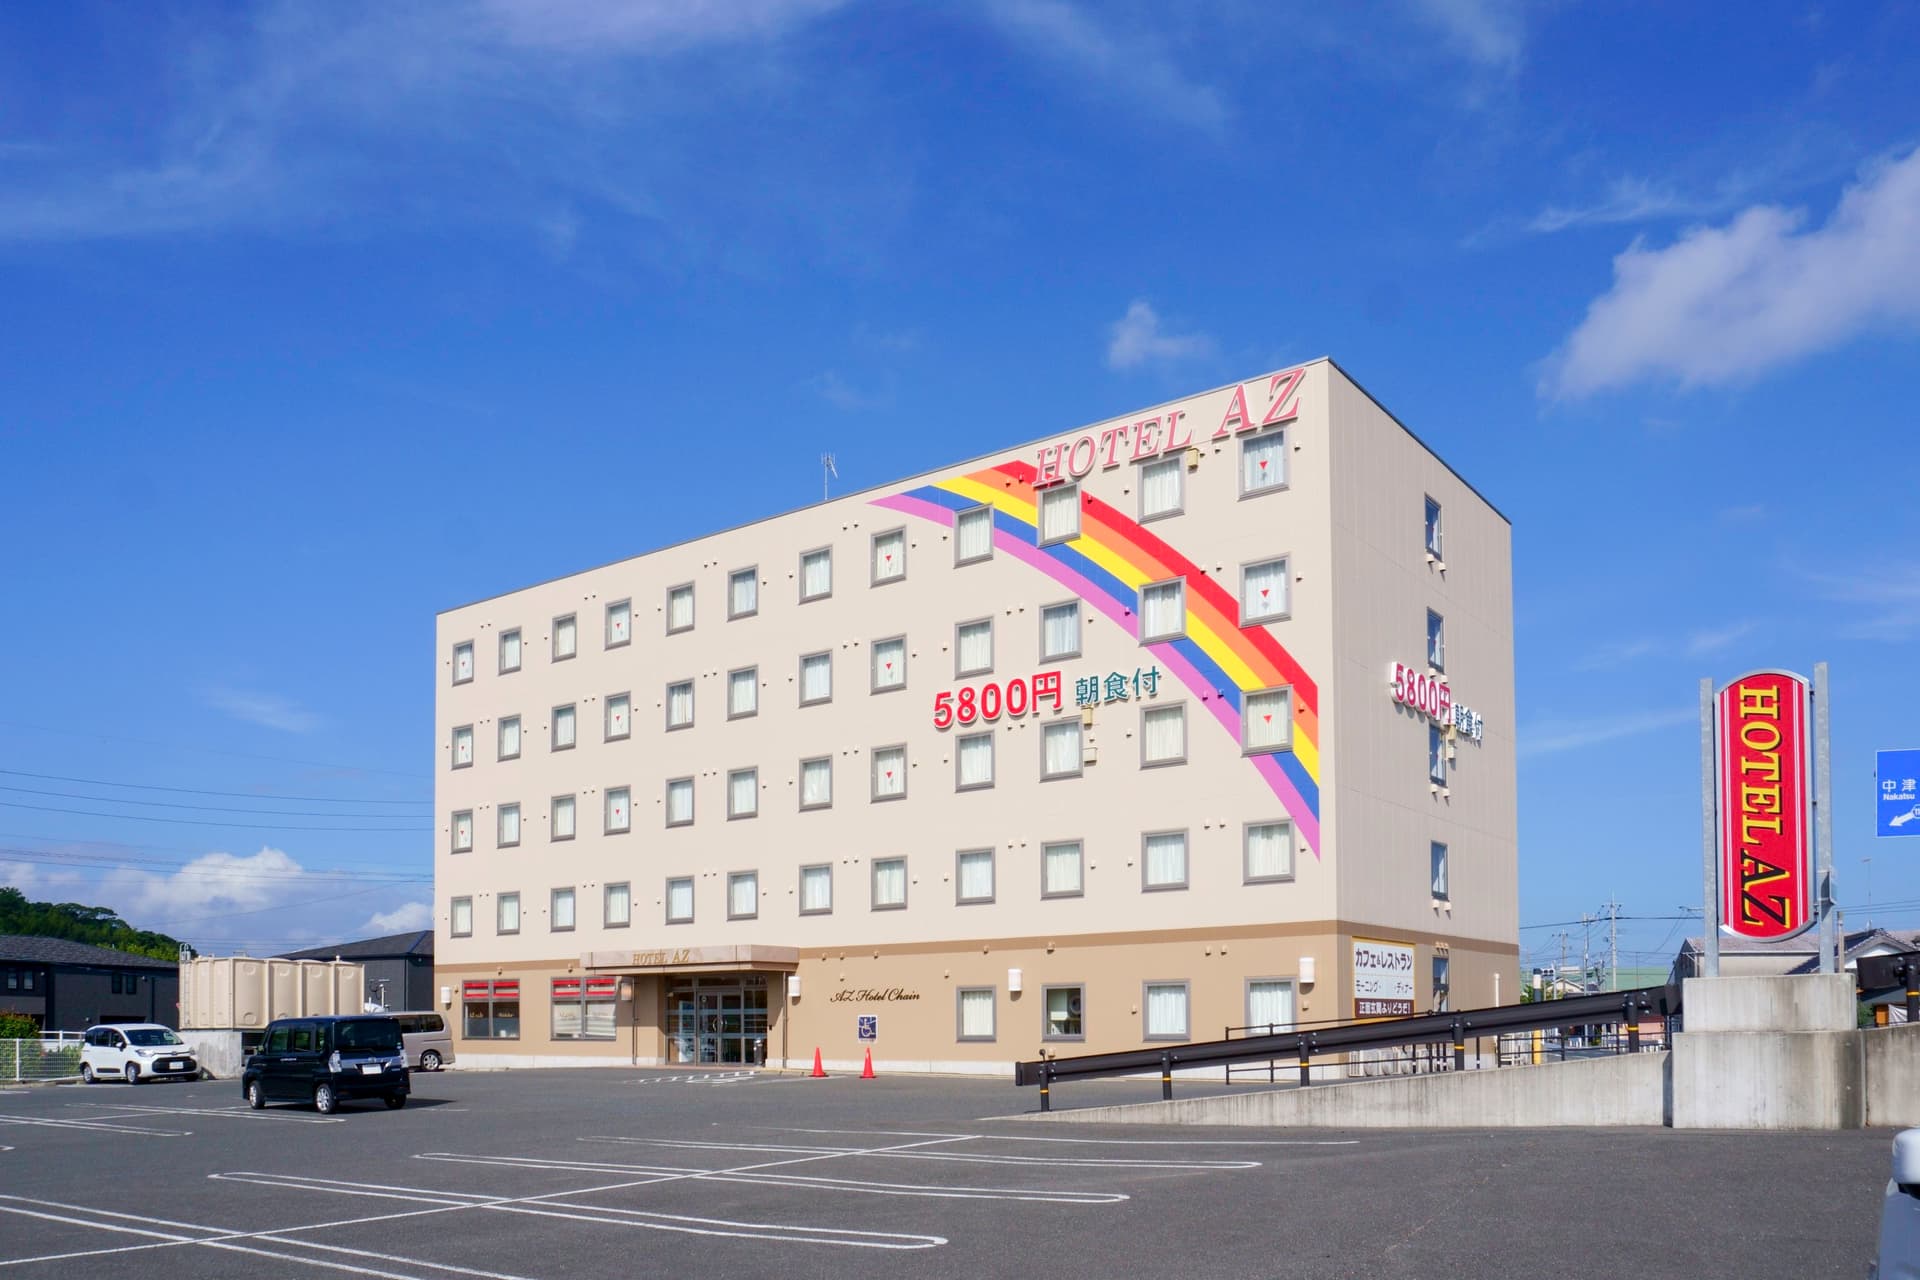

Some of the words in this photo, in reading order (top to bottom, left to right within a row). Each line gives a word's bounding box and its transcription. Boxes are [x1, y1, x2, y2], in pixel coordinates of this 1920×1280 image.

[1032, 409, 1193, 487] HOTEL
[1212, 367, 1305, 440] AZ
[933, 670, 1063, 729] 5800円
[1075, 665, 1162, 707] 朝食付
[1393, 662, 1451, 724] 5800円
[1739, 684, 1784, 845] HOTEL
[1882, 779, 1917, 792] 中津
[1882, 793, 1916, 801] Nakatsu
[1740, 848, 1791, 929] AZ
[632, 952, 668, 966] HOTEL
[671, 949, 690, 964] AZ
[829, 988, 855, 1003] AZ
[855, 988, 889, 1002] Hotel
[887, 987, 920, 1002] Chain
